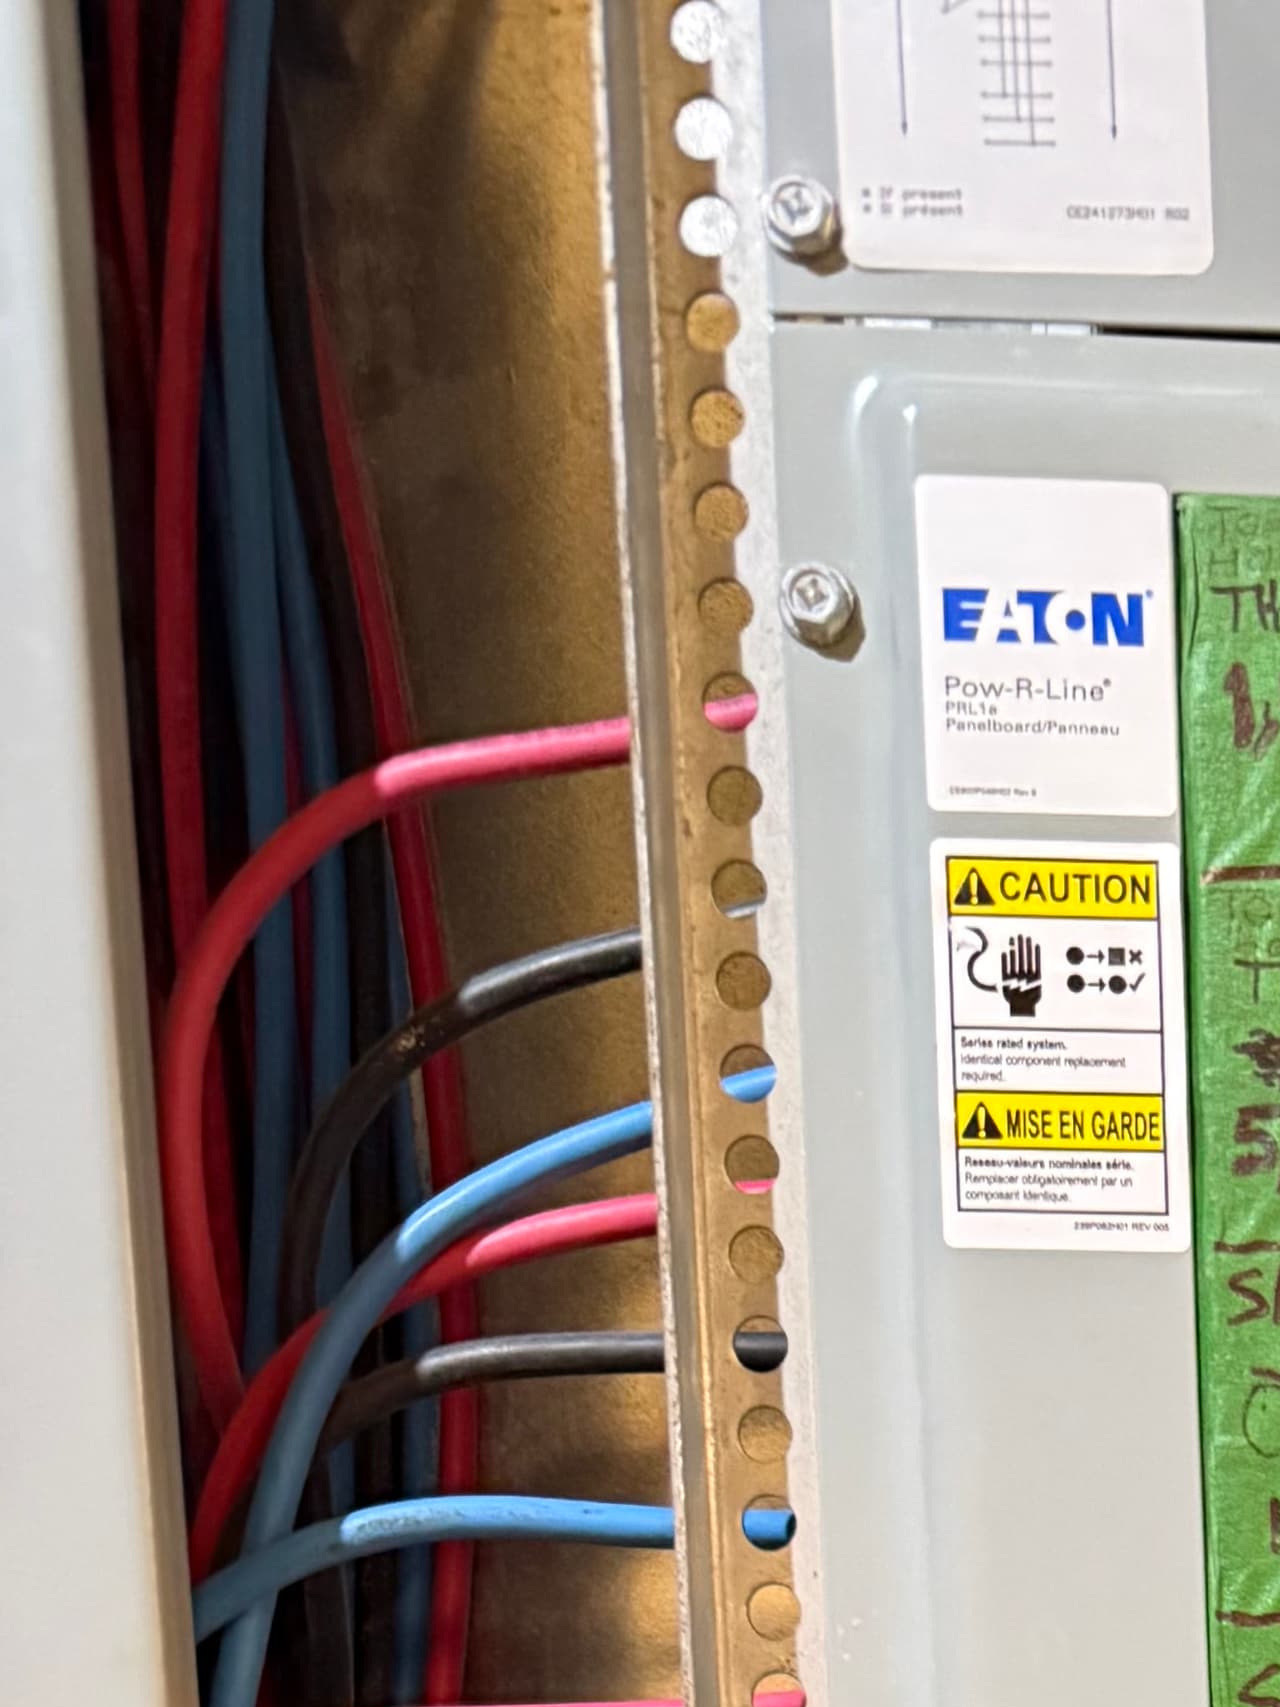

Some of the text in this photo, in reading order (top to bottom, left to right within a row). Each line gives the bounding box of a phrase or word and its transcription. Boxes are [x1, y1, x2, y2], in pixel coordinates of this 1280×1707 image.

[942, 587, 1145, 647] EATON
[946, 701, 998, 716] PRL1a
[946, 717, 1120, 737] Panelboard/Panneau
[999, 871, 1150, 905] CAUTION
[996, 1038, 1023, 1051] rated
[1005, 1054, 1126, 1072] component replacement
[1006, 1109, 1160, 1142] MISE EN GARDE
